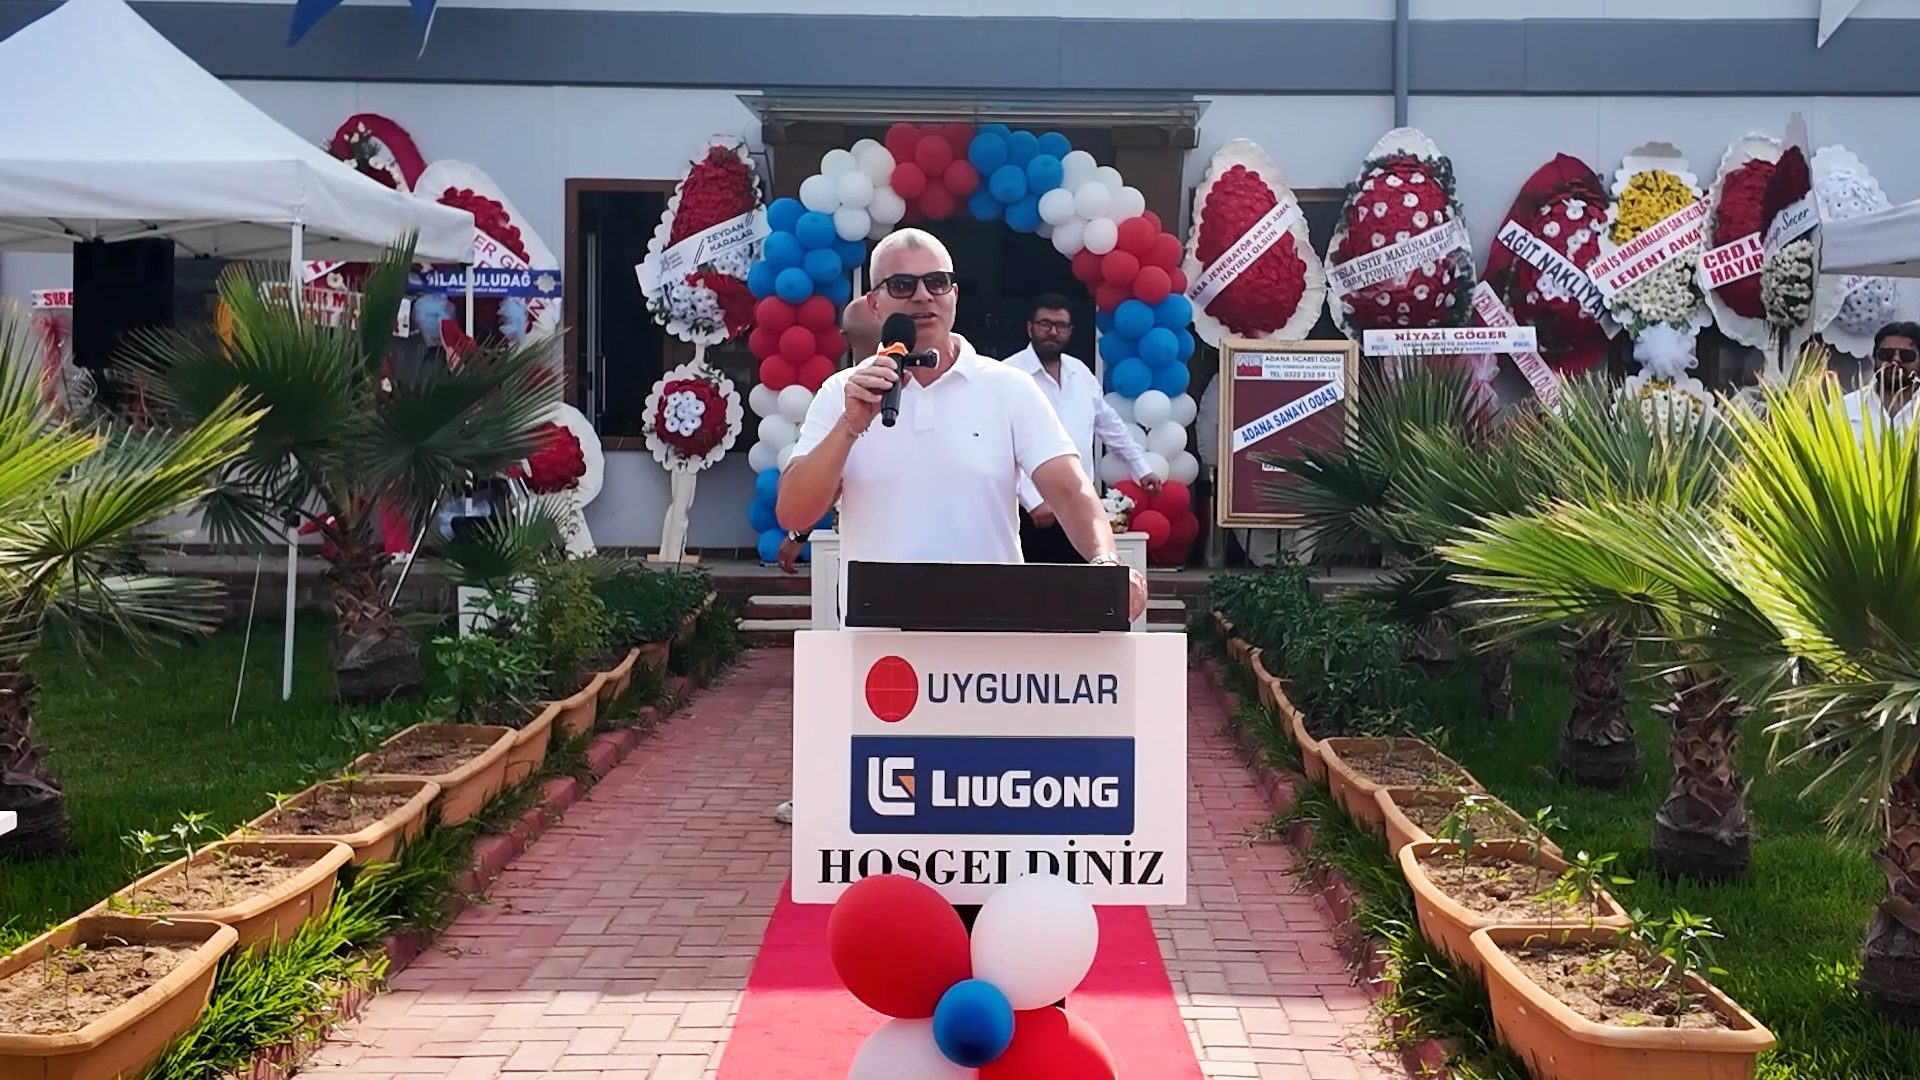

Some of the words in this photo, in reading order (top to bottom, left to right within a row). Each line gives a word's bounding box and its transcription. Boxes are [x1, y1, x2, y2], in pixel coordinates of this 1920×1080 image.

[706, 222, 745, 244] ZEYDAN
[709, 229, 754, 252] KARALAR
[1253, 221, 1273, 241] AKSA
[1220, 253, 1253, 283] HAYIRLI
[1252, 229, 1278, 254] OLSUN
[1610, 249, 1667, 290] LEVENT
[1668, 226, 1702, 254] AKKA
[1703, 243, 1745, 269] CRD
[473, 271, 531, 287] ULUDAĞ
[1395, 329, 1446, 342] NİYAZİ
[1454, 328, 1507, 340] GÖGER
[1513, 352, 1545, 380] AYIRLI
[1241, 419, 1275, 443] ADANA
[1273, 399, 1309, 427] SANAYİ
[1308, 386, 1338, 409] ODASI
[928, 672, 1119, 705] UYGUNLAR
